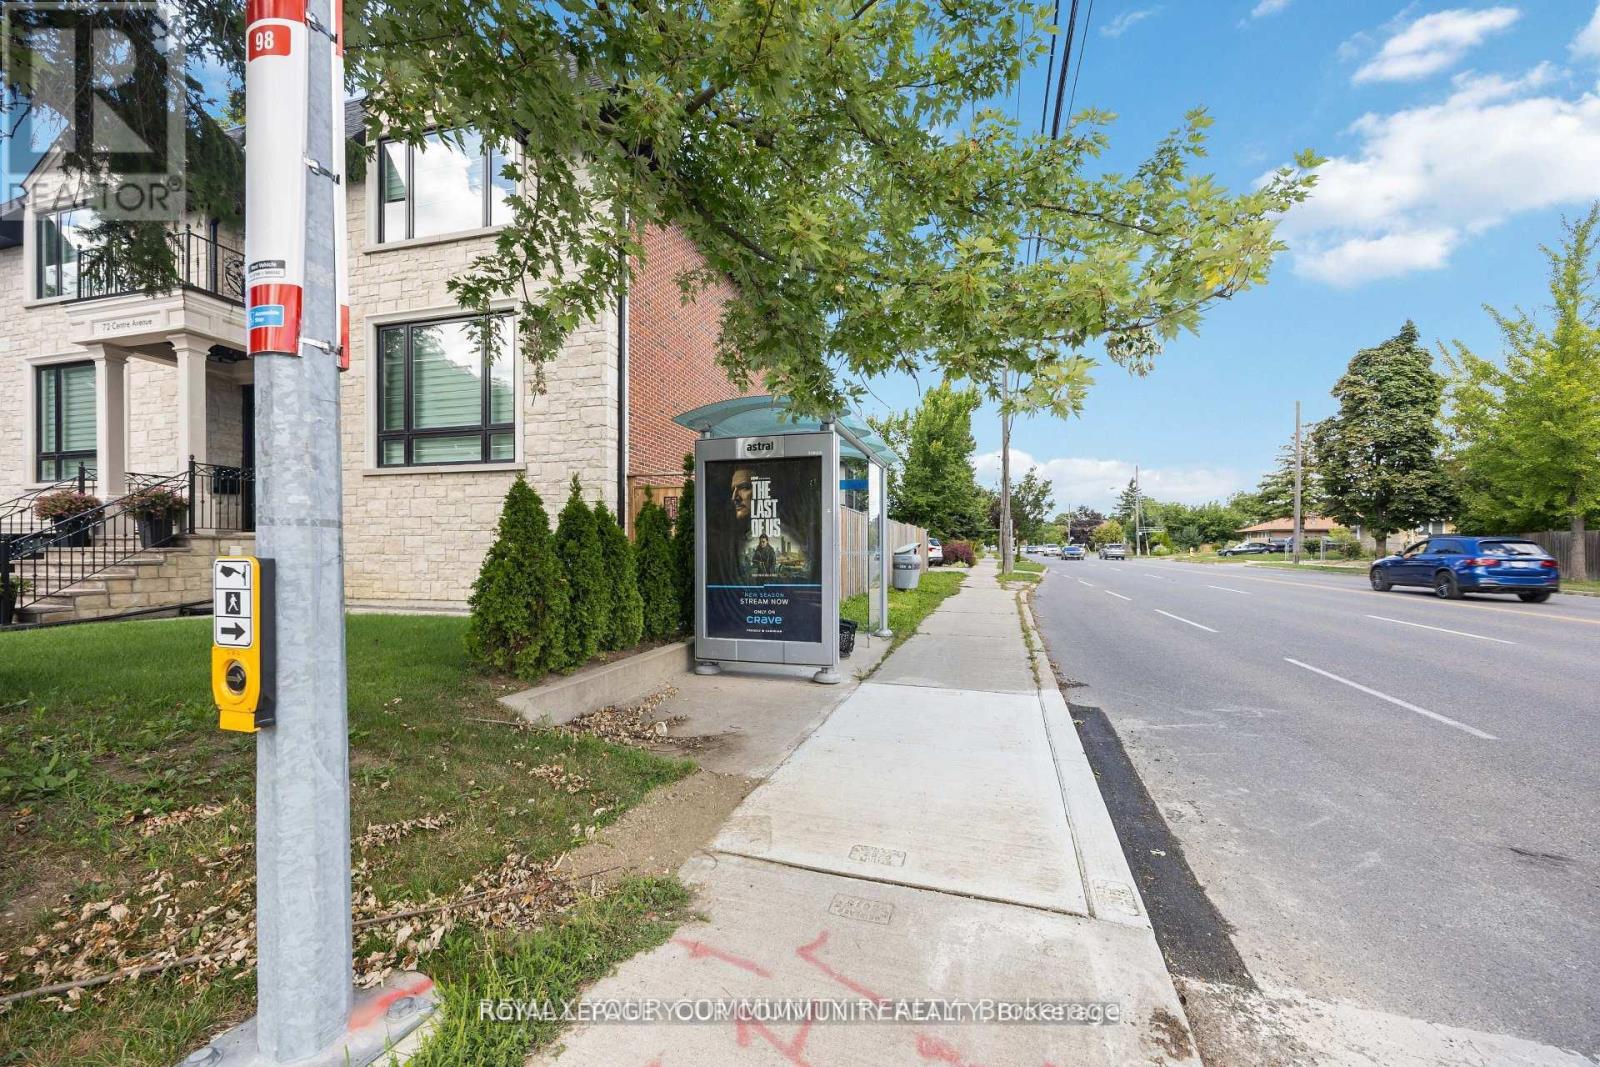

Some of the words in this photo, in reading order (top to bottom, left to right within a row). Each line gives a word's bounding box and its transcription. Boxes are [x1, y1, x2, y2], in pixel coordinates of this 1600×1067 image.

[256, 31, 274, 51] 98
[746, 441, 774, 452] astral
[751, 480, 771, 500] THE
[750, 498, 778, 518] LAST
[751, 518, 764, 538] OF
[765, 518, 781, 538] US
[740, 597, 769, 605] STREAM
